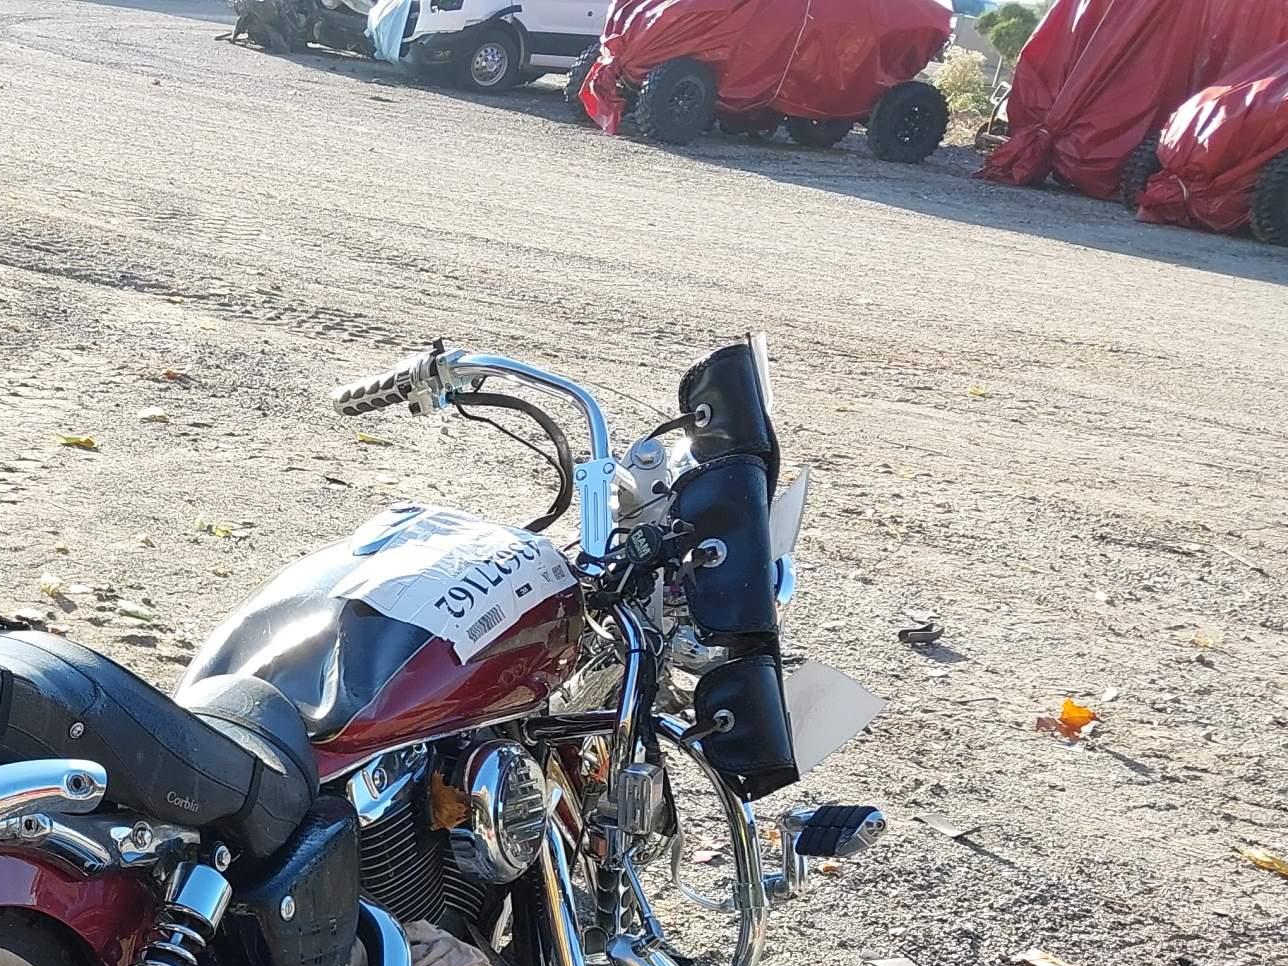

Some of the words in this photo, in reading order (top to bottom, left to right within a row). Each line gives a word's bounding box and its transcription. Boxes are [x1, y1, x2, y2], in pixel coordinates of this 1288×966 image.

[631, 529, 651, 559] RAM
[434, 539, 541, 619] 43627162
[167, 791, 200, 813] Corbin
